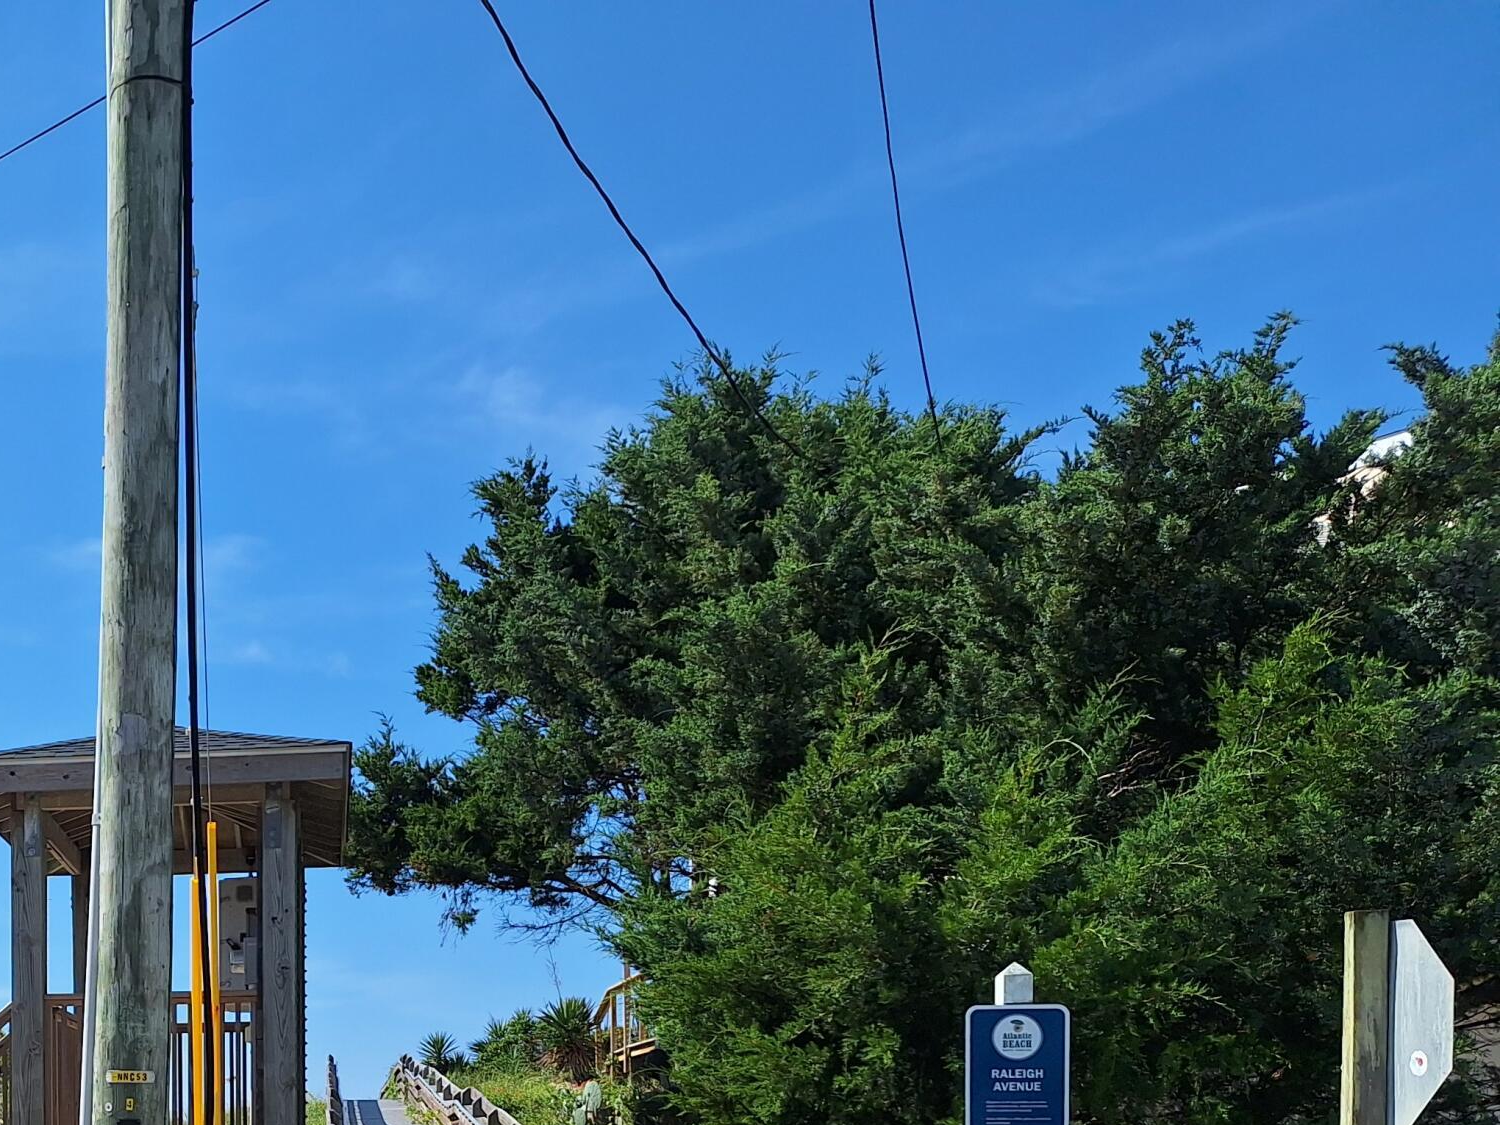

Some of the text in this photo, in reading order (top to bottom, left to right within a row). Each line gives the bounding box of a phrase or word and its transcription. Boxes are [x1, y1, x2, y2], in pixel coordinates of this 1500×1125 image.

[1002, 1032, 1032, 1040] Atlantic
[1002, 1040, 1032, 1048] BEACH
[991, 1068, 1044, 1080] RALEIGH
[992, 1081, 1042, 1092] AVENUE
